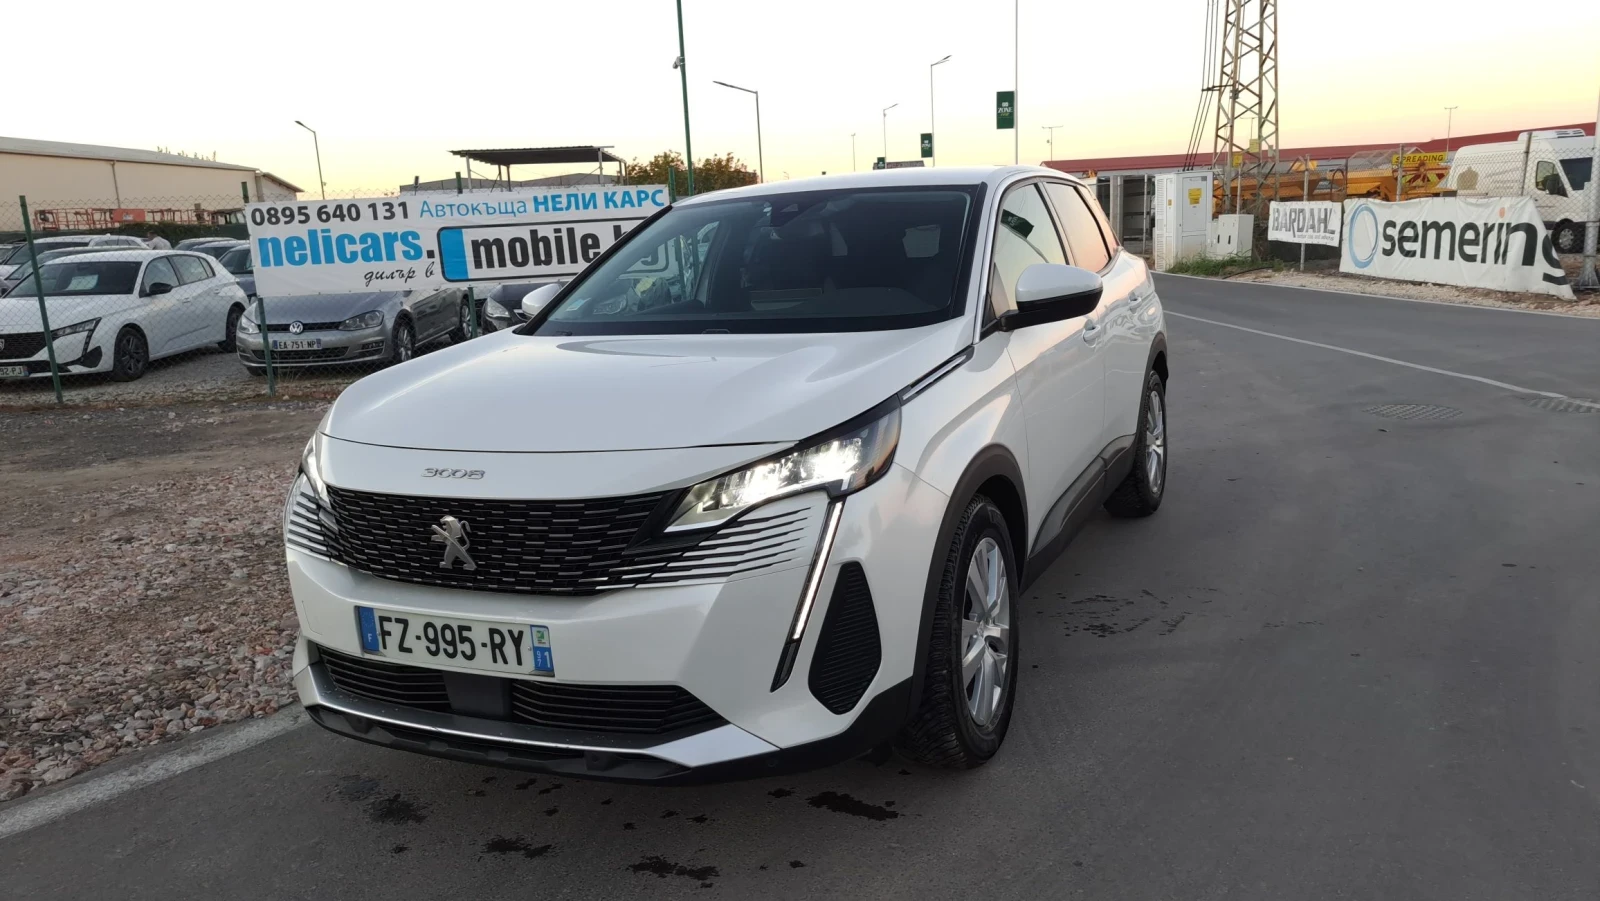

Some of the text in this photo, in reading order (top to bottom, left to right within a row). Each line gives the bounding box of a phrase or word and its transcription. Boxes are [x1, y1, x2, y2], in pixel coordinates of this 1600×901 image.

[1394, 155, 1443, 164] SPREADING
[251, 201, 409, 226] 0895 640 131
[420, 189, 665, 218] Автокъща НЕЛИ КАРС
[1272, 207, 1336, 238] BARDAHL
[364, 267, 417, 287] дилър
[421, 468, 486, 480] 3008
[367, 633, 373, 643] F
[378, 615, 524, 667] FZ-995-RY
